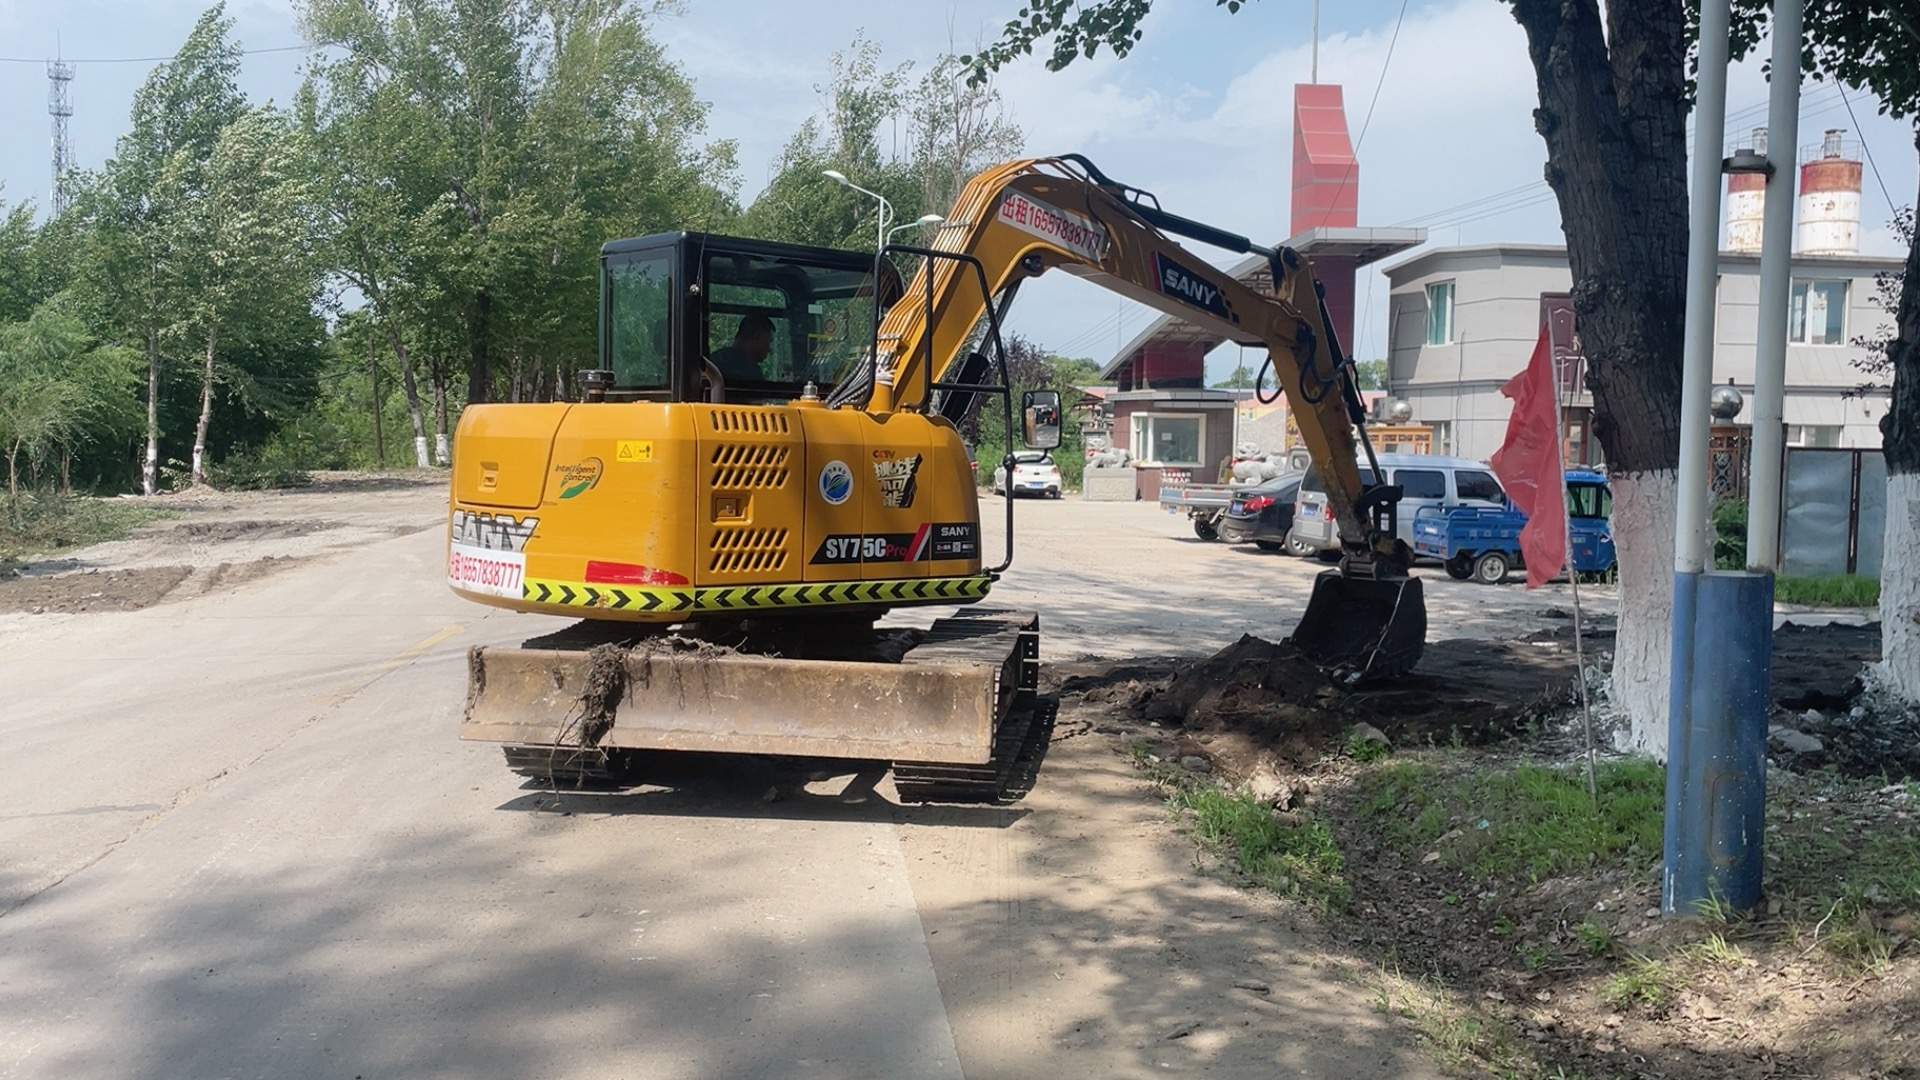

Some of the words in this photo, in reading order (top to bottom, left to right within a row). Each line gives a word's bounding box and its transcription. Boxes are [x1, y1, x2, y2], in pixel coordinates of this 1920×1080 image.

[1002, 193, 1101, 250] 出租16557838777
[1165, 268, 1216, 305] SANY
[452, 509, 540, 552] SANY
[825, 537, 887, 559] SY75C
[886, 544, 908, 557] Pro
[940, 526, 969, 537] SANY
